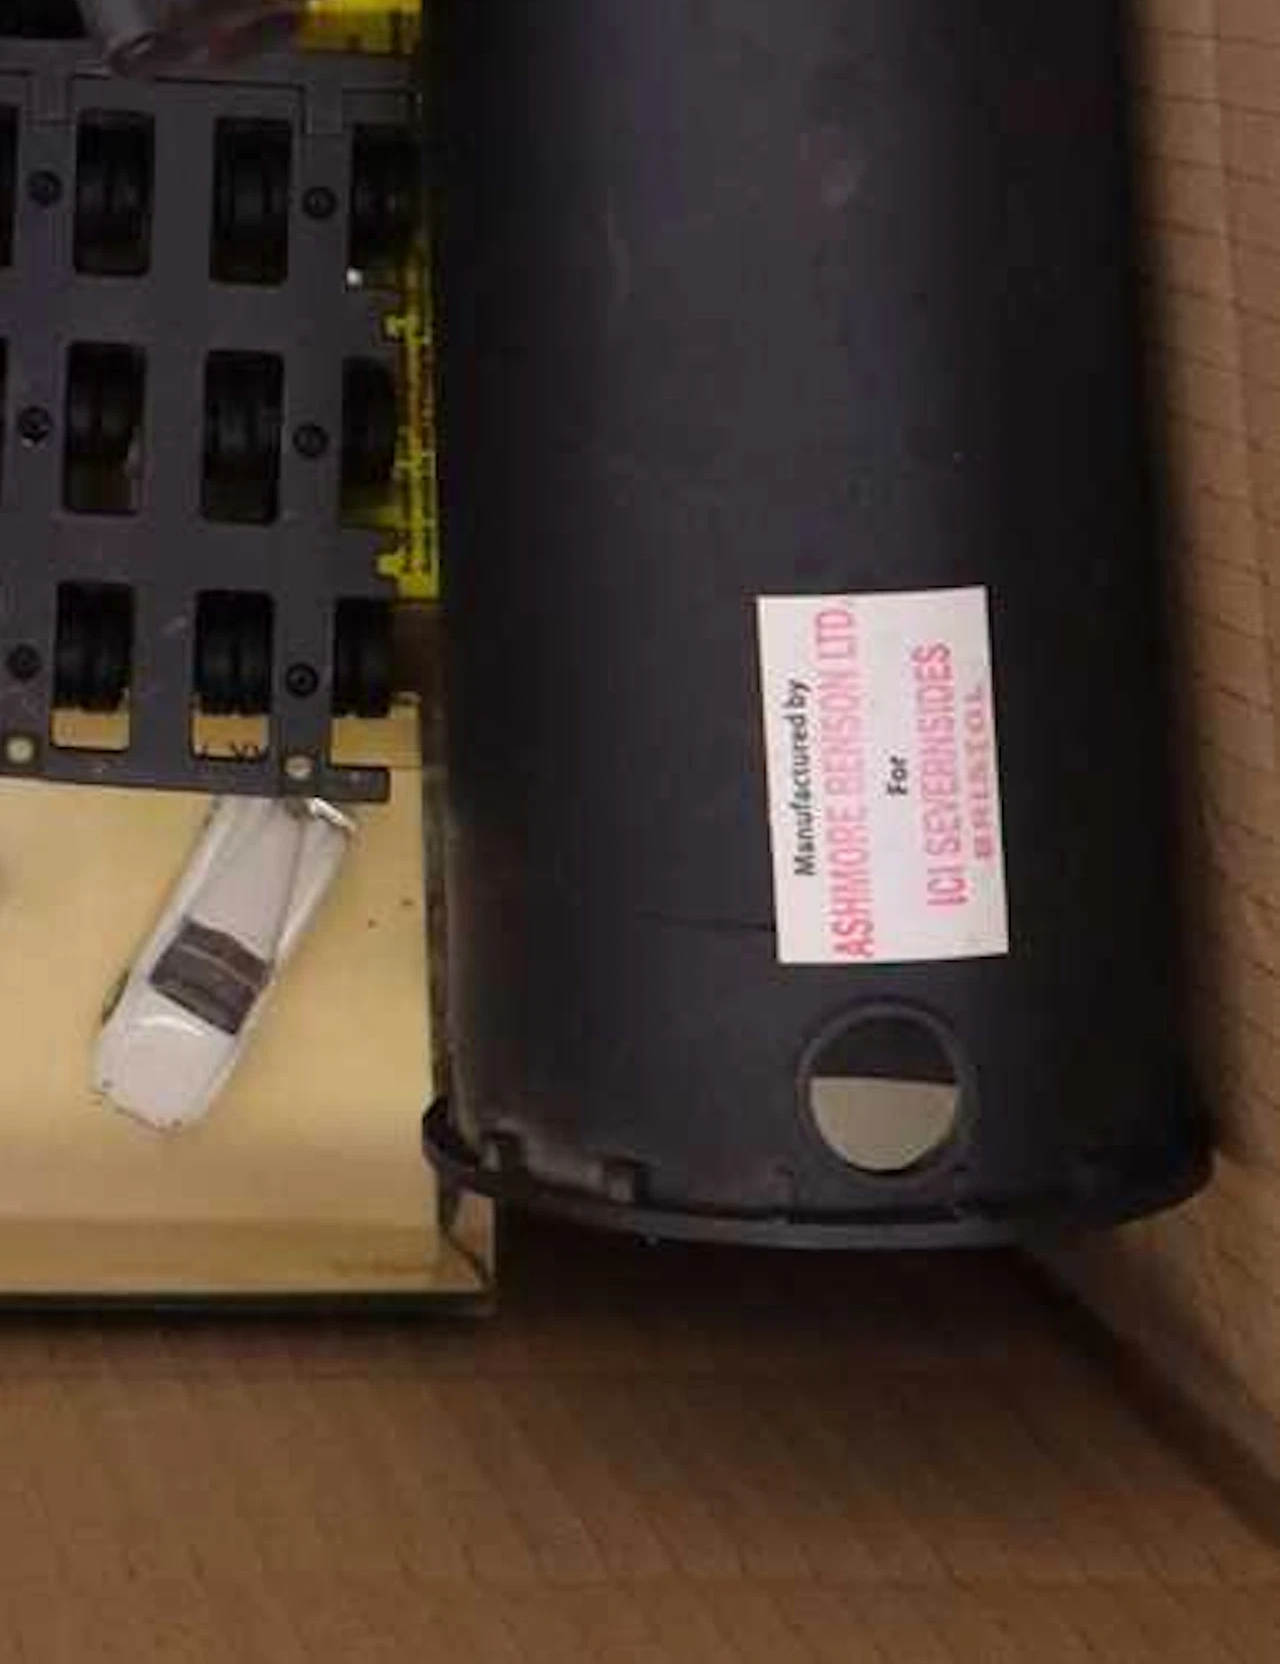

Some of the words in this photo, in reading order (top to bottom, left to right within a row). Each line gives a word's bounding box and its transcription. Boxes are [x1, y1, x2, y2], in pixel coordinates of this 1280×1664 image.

[784, 678, 812, 709] by
[819, 673, 868, 800] BENSON
[911, 642, 962, 857] SEVERNSIDES
[784, 715, 815, 876] Manufactured
[887, 755, 908, 796] For
[824, 809, 875, 959] ASHMORE
[927, 866, 969, 908] ICI
